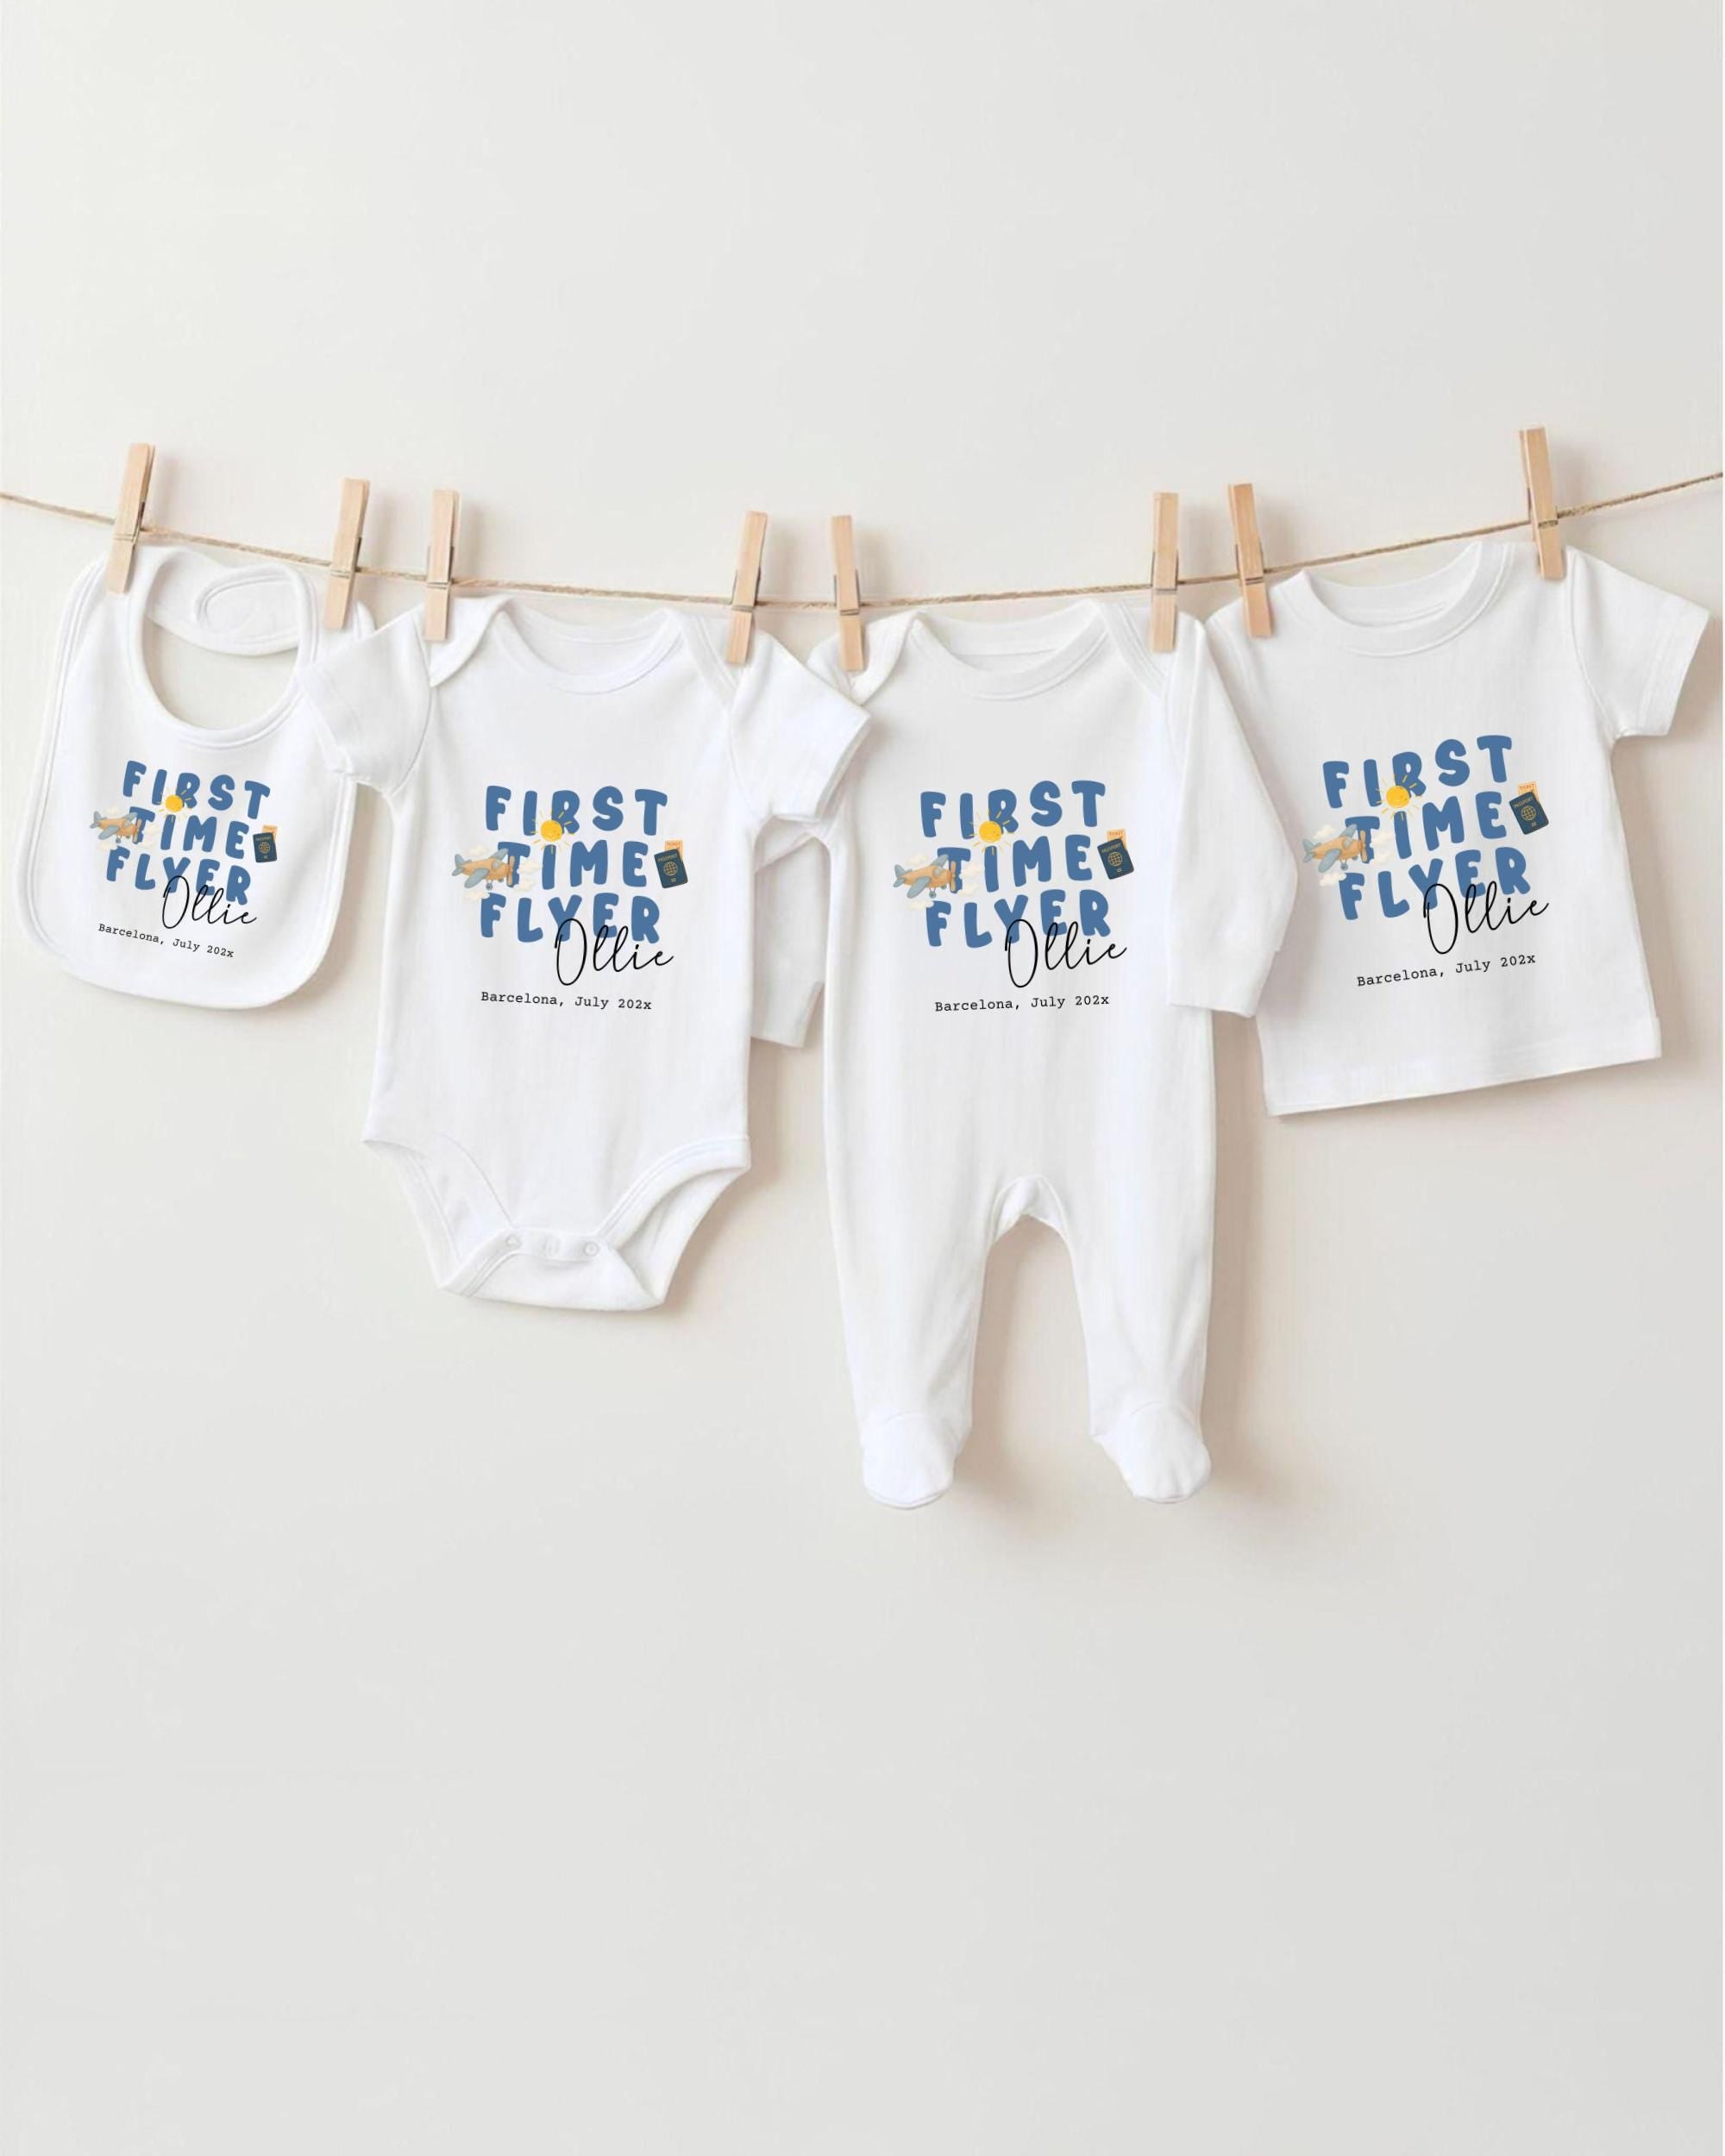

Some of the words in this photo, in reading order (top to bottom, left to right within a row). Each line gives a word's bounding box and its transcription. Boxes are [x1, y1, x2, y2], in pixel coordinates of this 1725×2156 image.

[123, 761, 271, 819] FIRST
[1322, 735, 1512, 809] FIRST
[129, 806, 249, 859] TIME
[486, 786, 668, 837] FIRST
[920, 780, 1106, 839] FIRST
[1345, 791, 1507, 864] TIME
[106, 846, 251, 905] FLYER
[498, 840, 648, 890] TIME
[937, 834, 1093, 893] TIME
[1339, 846, 1530, 920] FLYER
[162, 875, 257, 929] Ollie
[480, 893, 660, 944] FLYER
[925, 889, 1111, 948] FLYER
[1423, 881, 1549, 954] Ollie
[98, 924, 164, 945] Barcelona,
[172, 938, 200, 953] July
[206, 945, 235, 958] 202x
[555, 918, 674, 986] Ollie
[1005, 918, 1127, 988] Ollie
[1357, 966, 1445, 987] Barcelona,
[1455, 959, 1490, 974] July
[1500, 954, 1536, 968] 202x
[481, 992, 563, 1007] Barcelona,
[574, 996, 609, 1010] July
[618, 999, 652, 1010] 202x
[935, 999, 1019, 1012] Barcelona,
[1031, 996, 1066, 1009] July
[1075, 994, 1110, 1006] 202x
